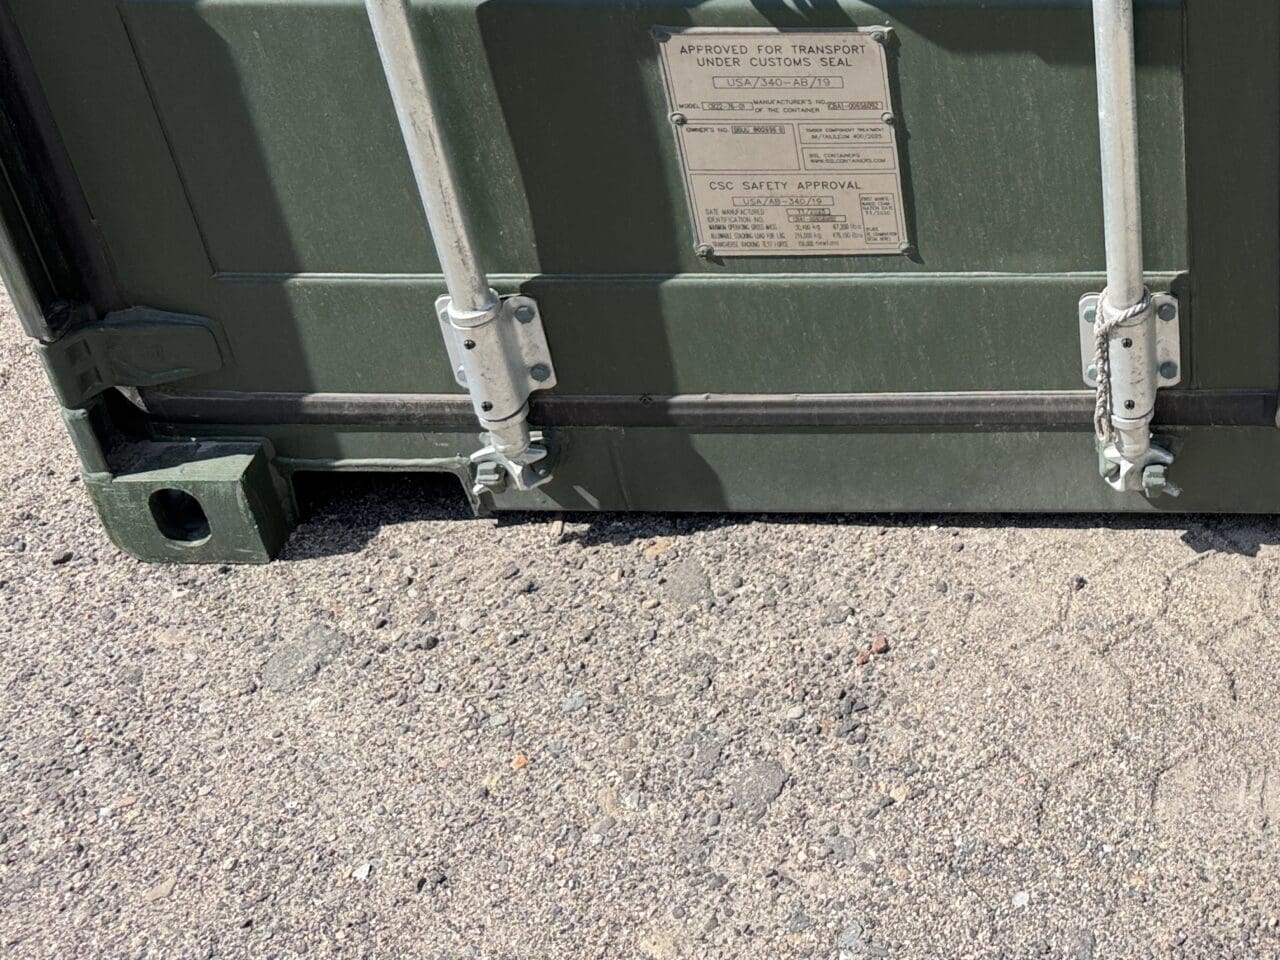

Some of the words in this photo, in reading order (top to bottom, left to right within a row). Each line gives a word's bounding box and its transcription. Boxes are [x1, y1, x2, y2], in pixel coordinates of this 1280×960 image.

[680, 44, 749, 55] APPROVED
[757, 44, 783, 55] FOR
[791, 44, 866, 55] TRANSPORT
[696, 57, 741, 67] UNDER
[750, 57, 812, 67] CUSTOMS
[820, 57, 853, 67] SEAL
[727, 77, 831, 88] USA/340-AB/19
[709, 181, 735, 191] CSC
[742, 181, 787, 191] SAFETY
[797, 181, 862, 191] APPROVAL
